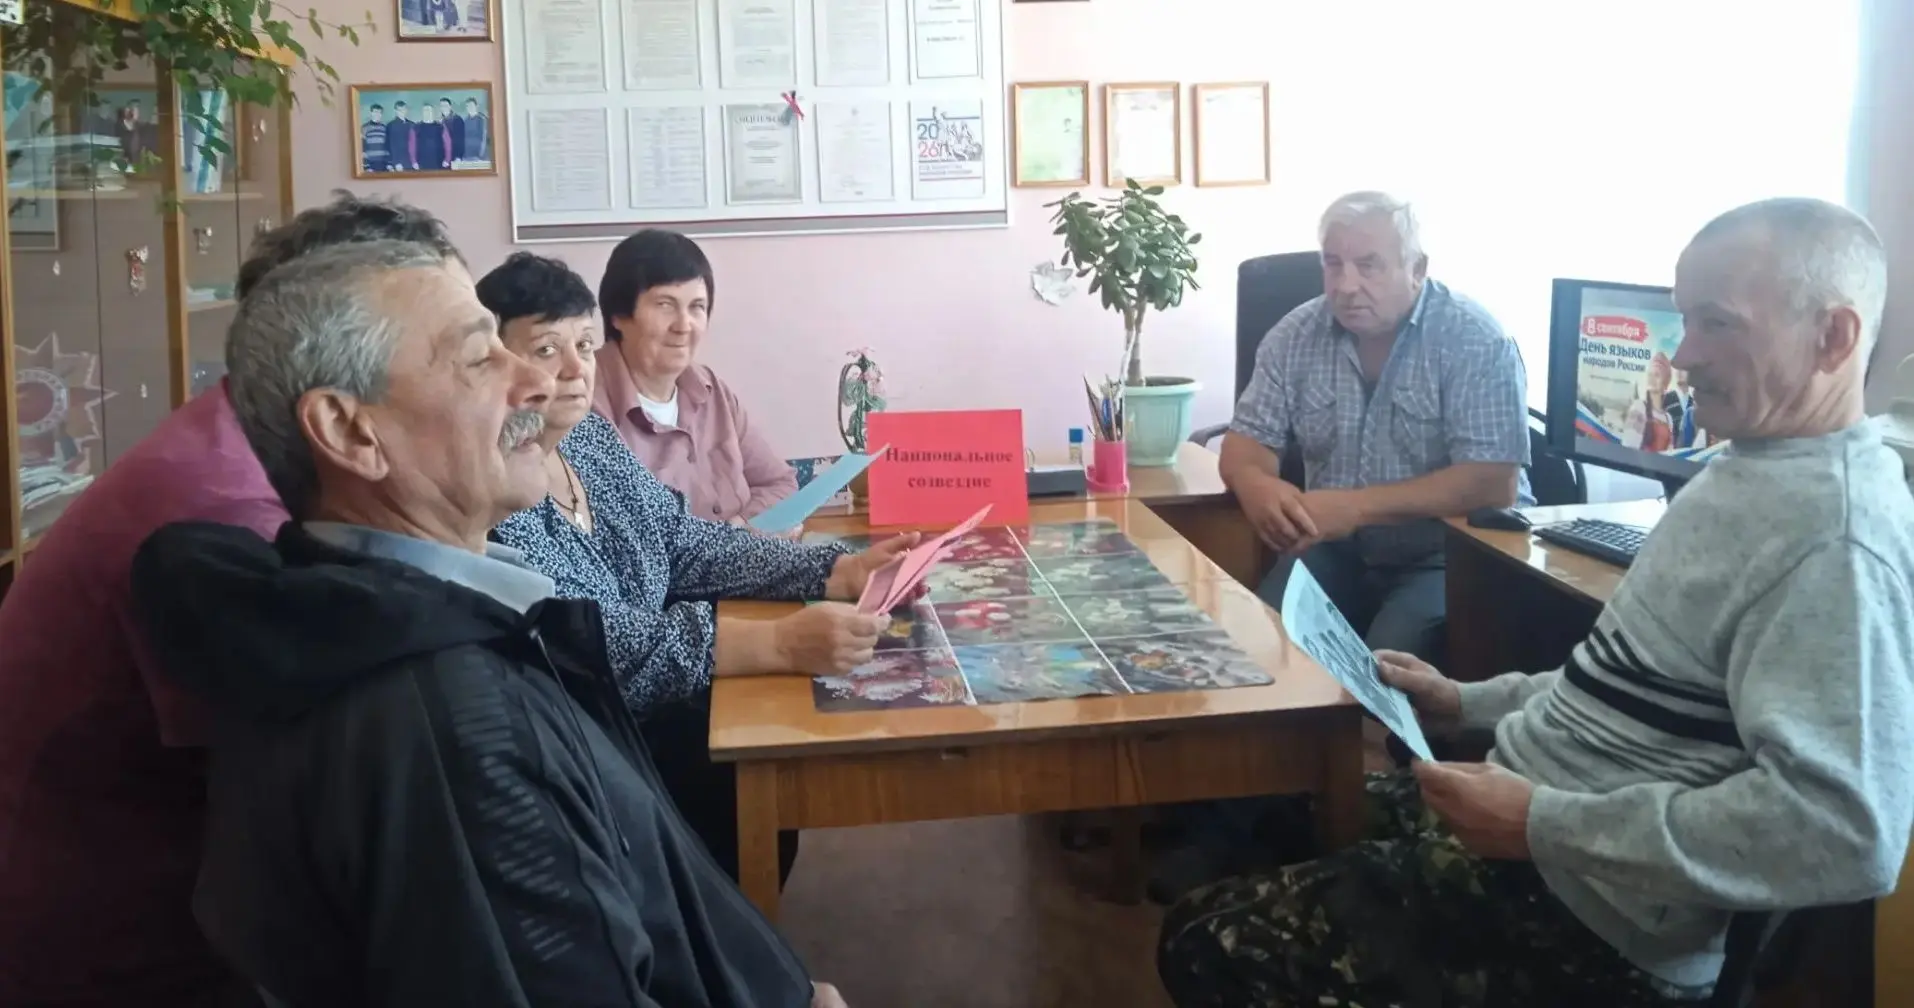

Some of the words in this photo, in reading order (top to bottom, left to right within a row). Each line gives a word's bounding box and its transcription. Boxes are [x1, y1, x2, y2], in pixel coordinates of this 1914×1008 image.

[917, 123, 939, 140] 20
[918, 141, 938, 158] 26
[1597, 322, 1640, 338] сентября
[1579, 338, 1606, 353] День
[1609, 344, 1651, 360] языков
[1583, 356, 1615, 368] народов
[1617, 359, 1646, 372] России
[886, 447, 1013, 463] Национальное
[908, 476, 992, 488] созвездие
